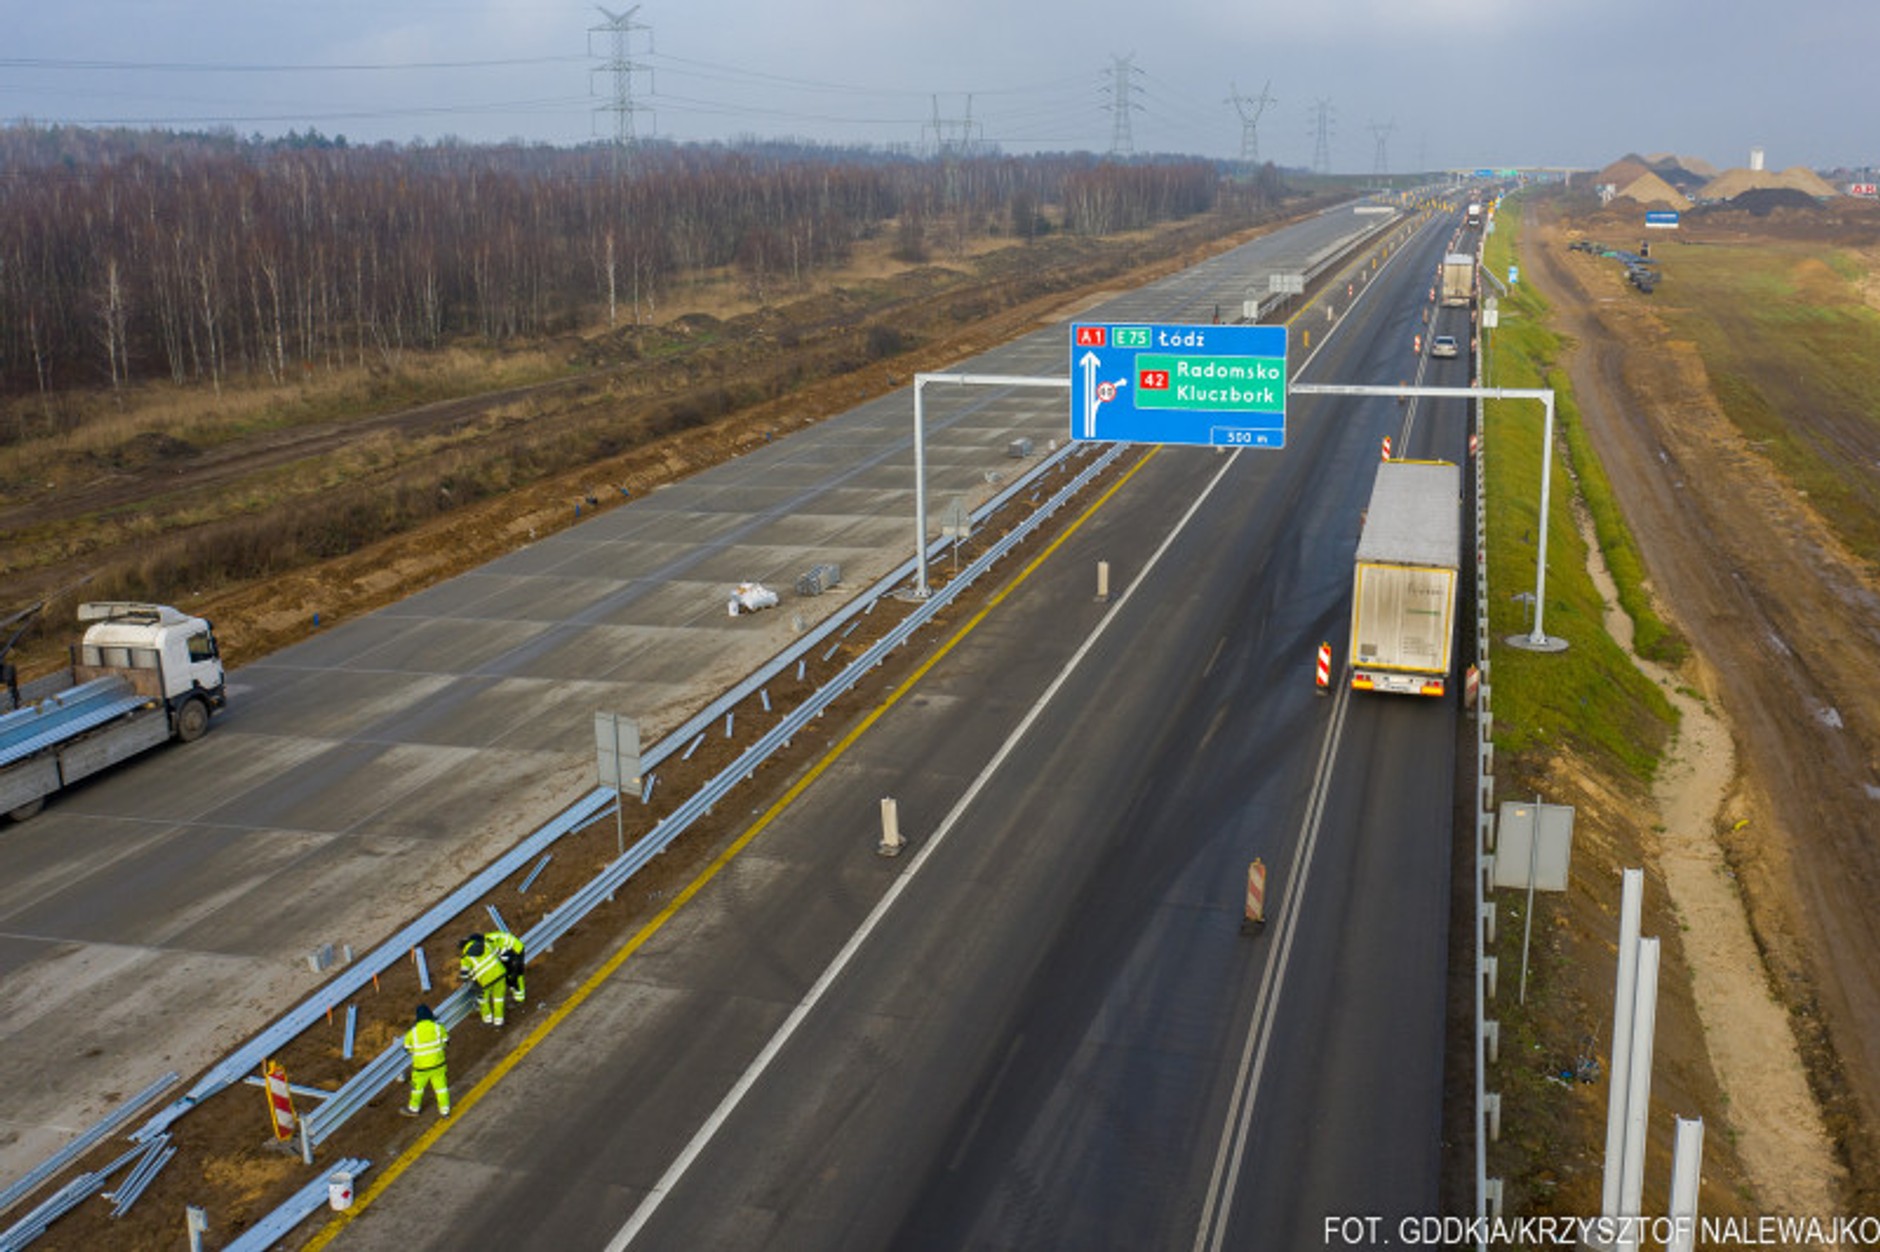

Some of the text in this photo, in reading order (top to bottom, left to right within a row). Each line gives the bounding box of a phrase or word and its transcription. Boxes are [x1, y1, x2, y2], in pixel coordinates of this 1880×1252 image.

[1158, 330, 1205, 347] Łódź
[1177, 361, 1280, 380] Radomsko
[1144, 374, 1164, 387] 42
[1177, 385, 1275, 403] Kluczbork
